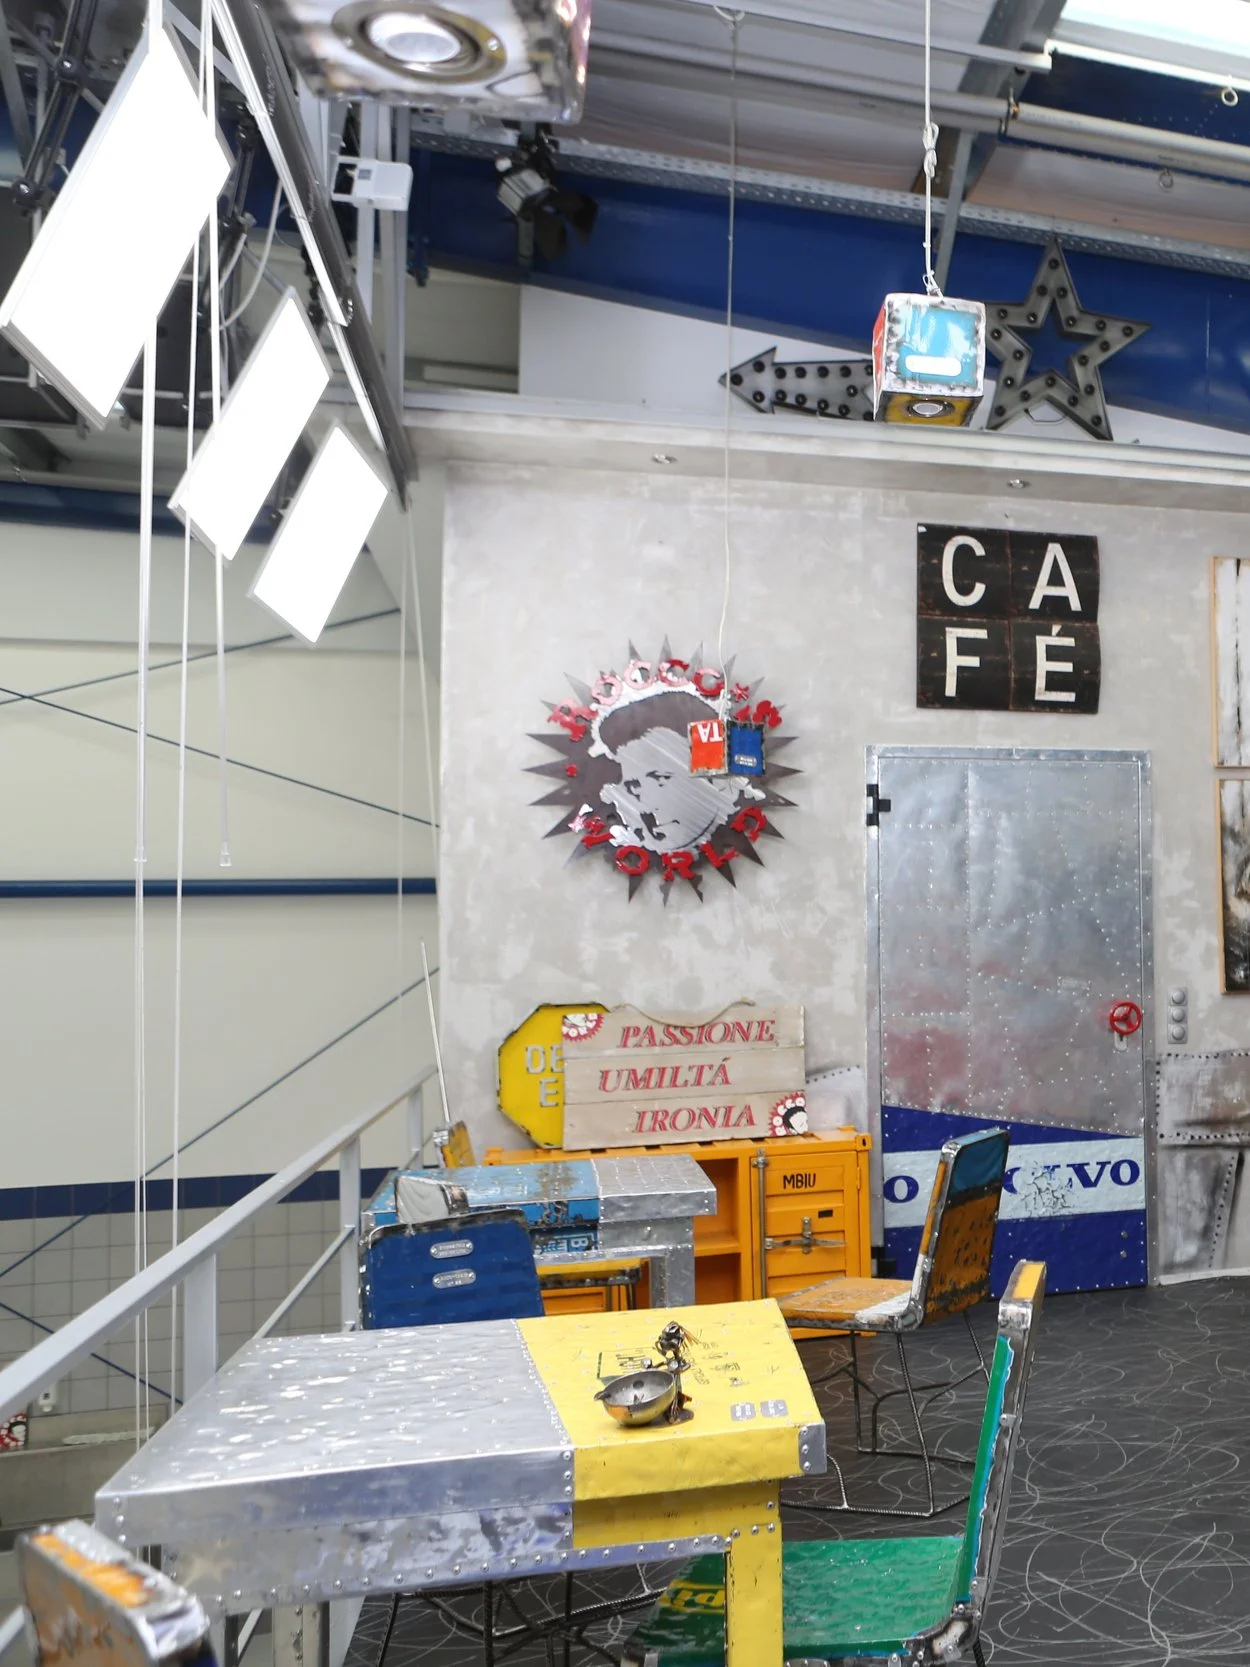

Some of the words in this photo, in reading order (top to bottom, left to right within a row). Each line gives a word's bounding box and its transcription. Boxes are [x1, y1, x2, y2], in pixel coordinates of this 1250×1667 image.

[618, 1019, 776, 1049] PASSIONE
[600, 1056, 732, 1093] UMILTÁ
[633, 1104, 756, 1134] IRONIA
[783, 1173, 817, 1190] MBIU
